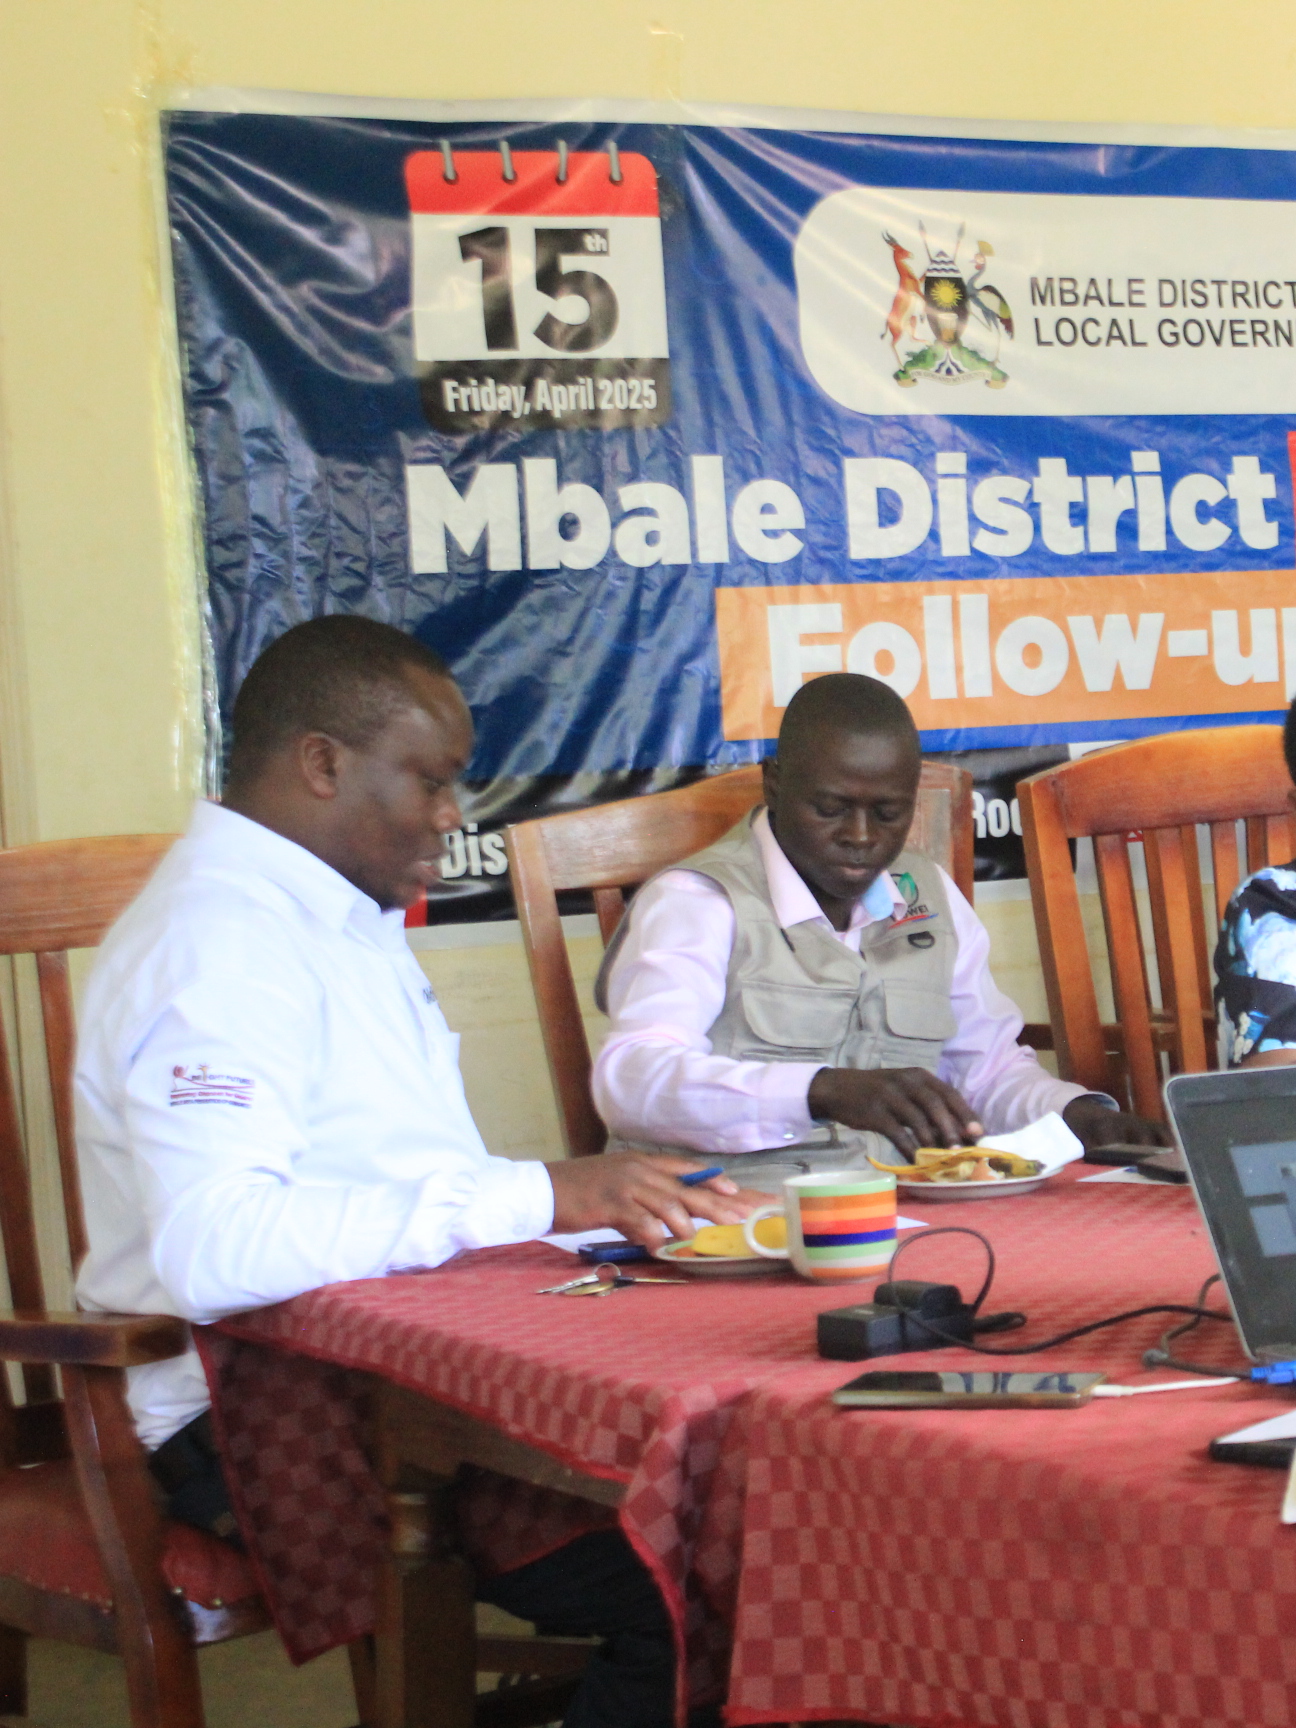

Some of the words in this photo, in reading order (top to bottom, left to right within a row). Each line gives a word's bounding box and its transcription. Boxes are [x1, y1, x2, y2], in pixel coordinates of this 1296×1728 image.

[458, 226, 619, 353] 15
[583, 234, 608, 251] th
[1030, 277, 1147, 307] MBALE
[1034, 317, 1148, 347] LOCAL
[443, 377, 531, 419] Friday,
[535, 377, 595, 418] April
[599, 379, 657, 410] 2025
[406, 455, 806, 574] Mbale
[843, 450, 1281, 560] District
